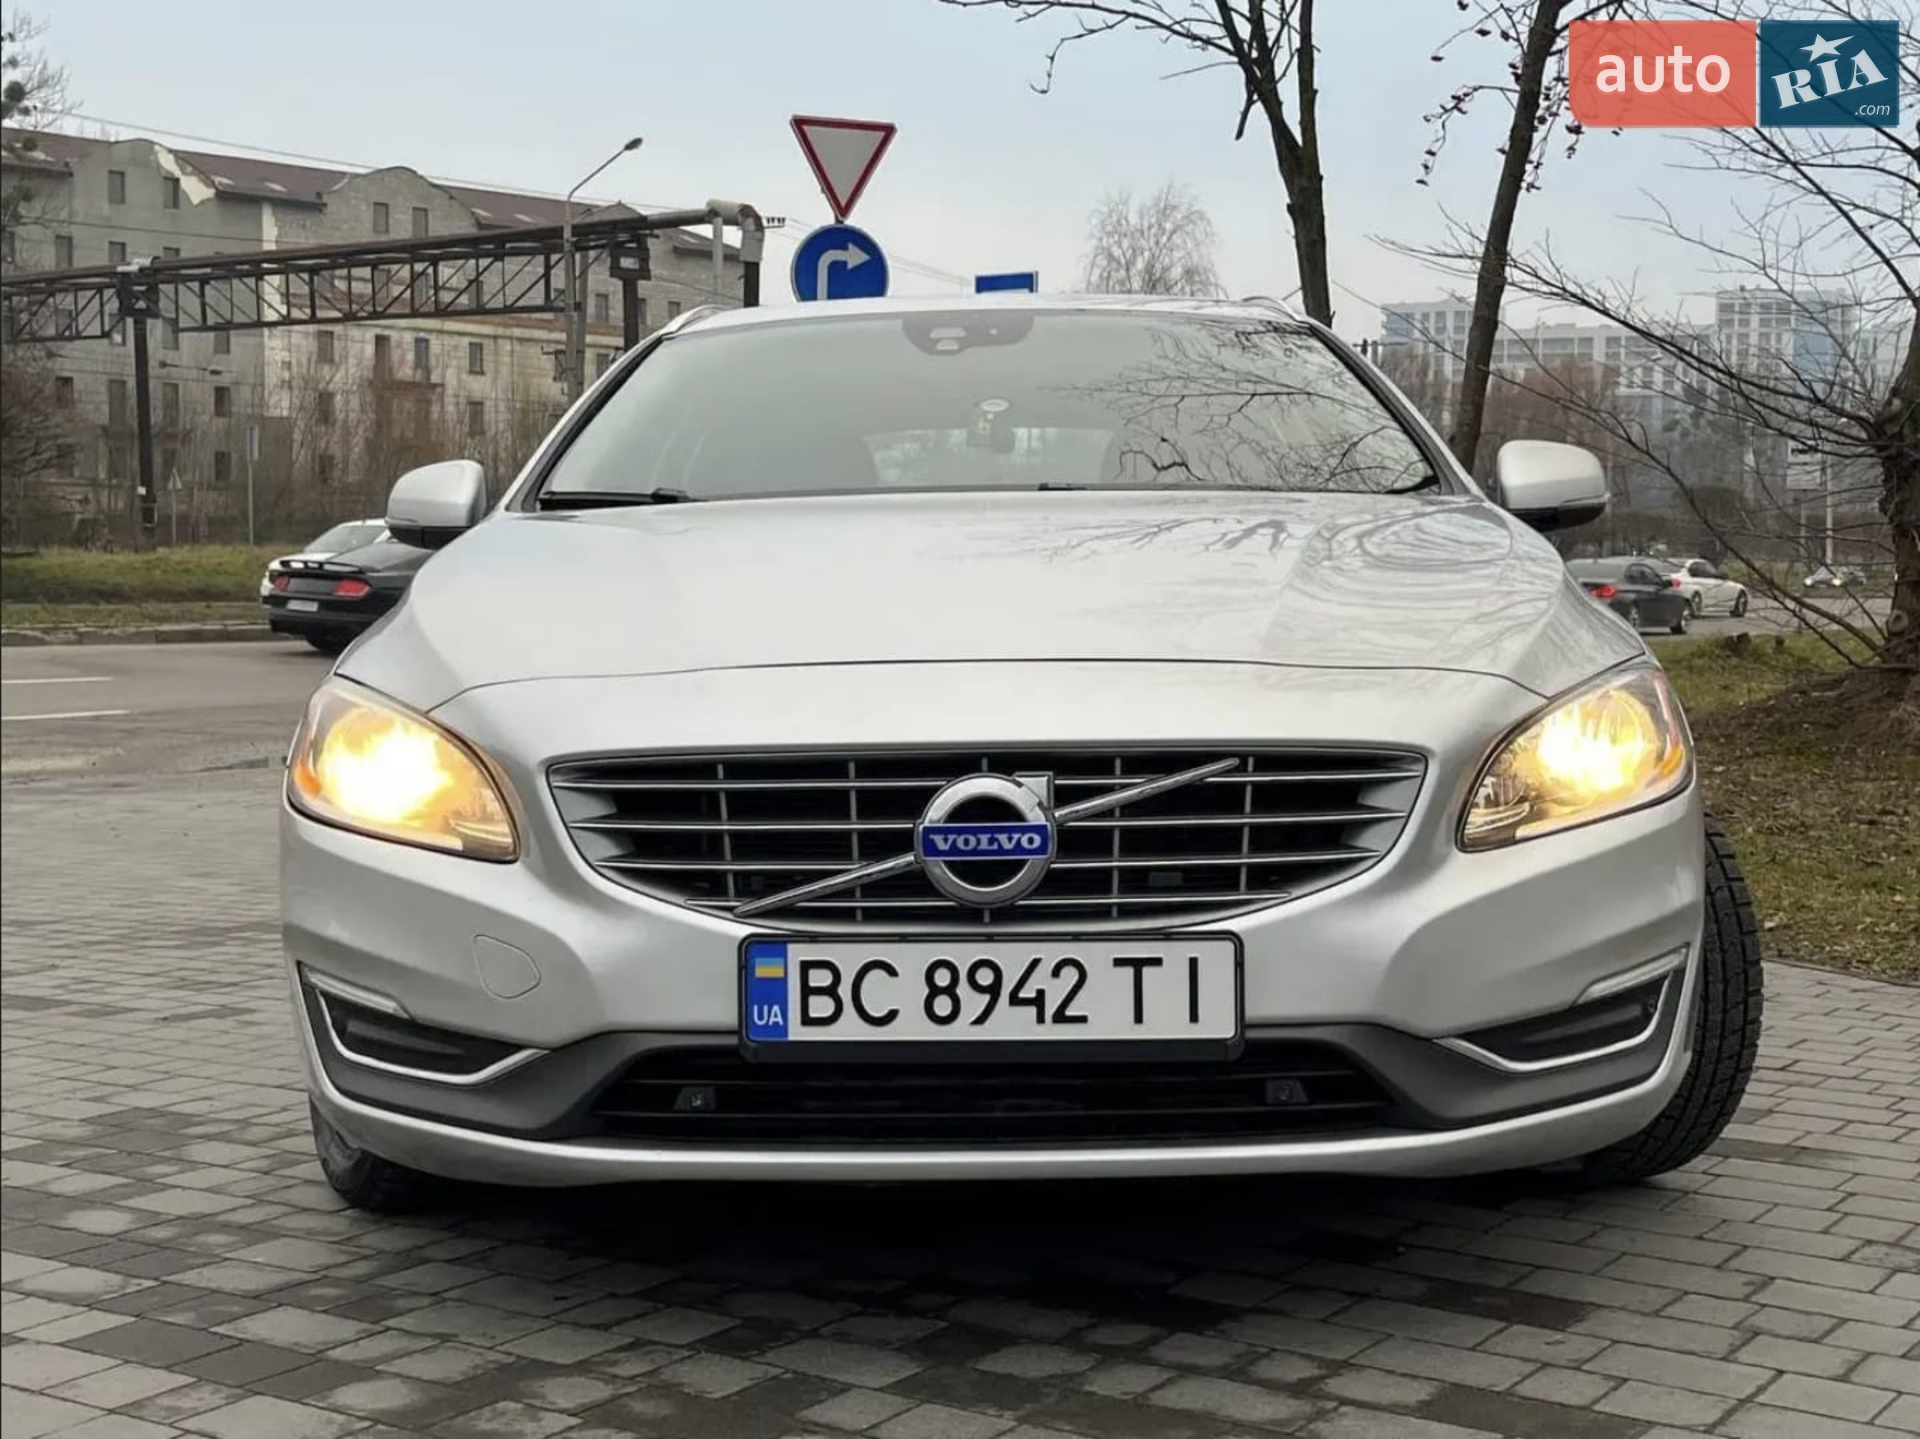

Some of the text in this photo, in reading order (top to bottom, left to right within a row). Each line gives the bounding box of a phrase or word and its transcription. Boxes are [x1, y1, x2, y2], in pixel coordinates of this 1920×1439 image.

[929, 832, 1042, 851] VOLVO
[799, 956, 1200, 1027] BC 8942 TI
[753, 1005, 783, 1026] UA
